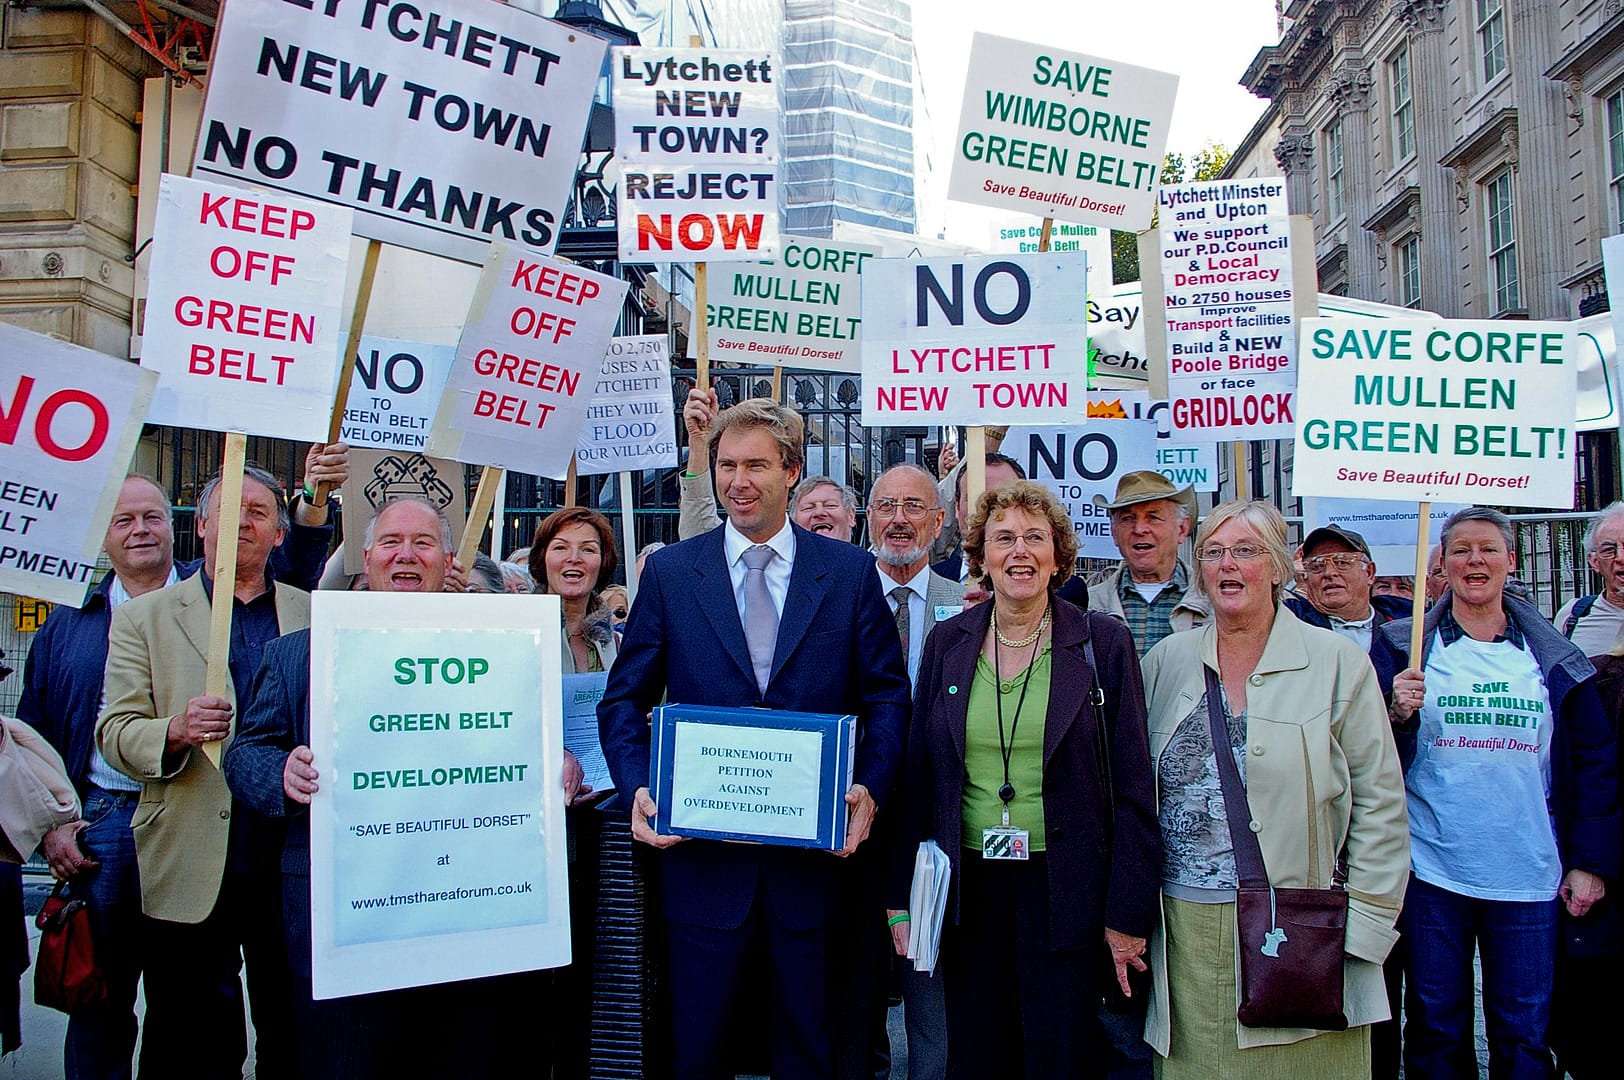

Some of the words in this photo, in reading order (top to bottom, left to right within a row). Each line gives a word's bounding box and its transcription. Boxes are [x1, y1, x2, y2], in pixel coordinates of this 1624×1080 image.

[281, 0, 561, 86] TCHETT
[623, 55, 772, 86] Lytchett
[1033, 55, 1112, 97] SAVE
[256, 36, 388, 108] NEW
[403, 80, 552, 158] TOWN
[656, 90, 742, 118] NEW
[985, 90, 1151, 149] WIMBORNE
[632, 125, 769, 154] TOWN?
[962, 132, 1069, 177] GREEN
[1075, 151, 1157, 192] BELT!
[202, 119, 298, 179] NO
[321, 150, 556, 247] THANKS
[625, 173, 774, 200] REJECT
[1159, 187, 1220, 208] Lytchett
[1222, 183, 1282, 201] Minster
[983, 180, 1015, 196] Save
[1018, 186, 1077, 207] Beautiful
[1079, 197, 1126, 216] Dorset!
[200, 192, 316, 241] KEEP
[1176, 207, 1205, 221] and
[1215, 202, 1267, 220] Upton
[637, 213, 765, 251] NOW
[1000, 228, 1026, 239] Save
[1028, 226, 1057, 237] Coe
[1060, 225, 1097, 236] Mullen
[1174, 230, 1199, 242] We
[1204, 223, 1269, 242] support
[1054, 240, 1079, 251] Belt!
[1164, 246, 1191, 259] our
[210, 245, 296, 286] OFF
[1188, 260, 1201, 272] &
[1208, 254, 1259, 271] Local
[511, 259, 600, 306] KEEP
[733, 273, 841, 306] MULLEN
[1174, 267, 1280, 287] Democracy
[916, 261, 1031, 327] NO
[1166, 295, 1187, 307] No
[1192, 291, 1230, 306] 2750
[1235, 288, 1291, 302] houses
[174, 295, 316, 345] GREEN
[1086, 301, 1140, 330] Say
[1168, 317, 1233, 333] Transport
[1235, 313, 1291, 328] facilities
[1200, 304, 1257, 317] Improve
[510, 307, 577, 345] OFF
[797, 313, 862, 340] BELT
[1219, 330, 1231, 342] &
[627, 341, 661, 356] 2,750
[717, 338, 745, 351] Save
[748, 341, 799, 356] Beautiful
[801, 347, 843, 360] Dorset!
[1172, 342, 1213, 355] Build
[1219, 343, 1228, 352] a
[1235, 335, 1283, 351] NEW
[1311, 328, 1412, 360] SAVE
[1425, 330, 1565, 364] CORFE
[188, 344, 295, 386] BELT
[642, 359, 662, 372] AT
[892, 344, 1056, 374] LYTCHETT
[1172, 357, 1222, 374] Poole
[1229, 353, 1289, 372] Bridge
[355, 350, 424, 394] NO
[474, 349, 581, 397] GREEN
[1200, 380, 1216, 391] or
[1220, 377, 1256, 389] face
[371, 397, 391, 410] TO
[877, 386, 949, 411] NEW
[973, 382, 1068, 409] TOWN
[1353, 375, 1516, 410] MULLEN
[0, 375, 109, 462] NO
[389, 414, 428, 429] BELT
[473, 390, 556, 429] BELT
[1172, 392, 1294, 429] GRIDLOCK
[341, 426, 429, 447] VELOPMEN
[592, 422, 656, 441] FLOOD
[1303, 419, 1439, 455] GREEN
[1453, 424, 1566, 459] BELT!
[578, 447, 608, 461] OUR
[612, 442, 674, 457] VILLAGE
[1028, 432, 1118, 481] NO
[1156, 468, 1207, 483] OWN
[1336, 467, 1378, 483] Save
[1382, 468, 1461, 486] Beautiful
[1465, 472, 1531, 489] Dorset!
[0, 481, 58, 511] EEN
[1059, 485, 1082, 499] TO
[393, 657, 489, 685] STOP
[1472, 681, 1509, 694] SAVE
[1437, 695, 1485, 708] CORFE
[1487, 696, 1544, 713] MULLEN
[369, 713, 450, 733] GREEN
[459, 711, 513, 730] BELT
[1444, 712, 1492, 725] GREEN
[701, 746, 793, 763] BOURNEMOUTH
[1457, 736, 1506, 751] Beautiful
[353, 764, 528, 790] DEVELOPMENT
[718, 765, 773, 779] PETITION
[718, 783, 771, 796] AGAINST
[683, 797, 805, 817] OVERDEVELOPMENT
[395, 818, 470, 834] BEAUTIFUL
[437, 854, 450, 866] at
[351, 881, 532, 910] www.tmsthareaforum.co.uk
